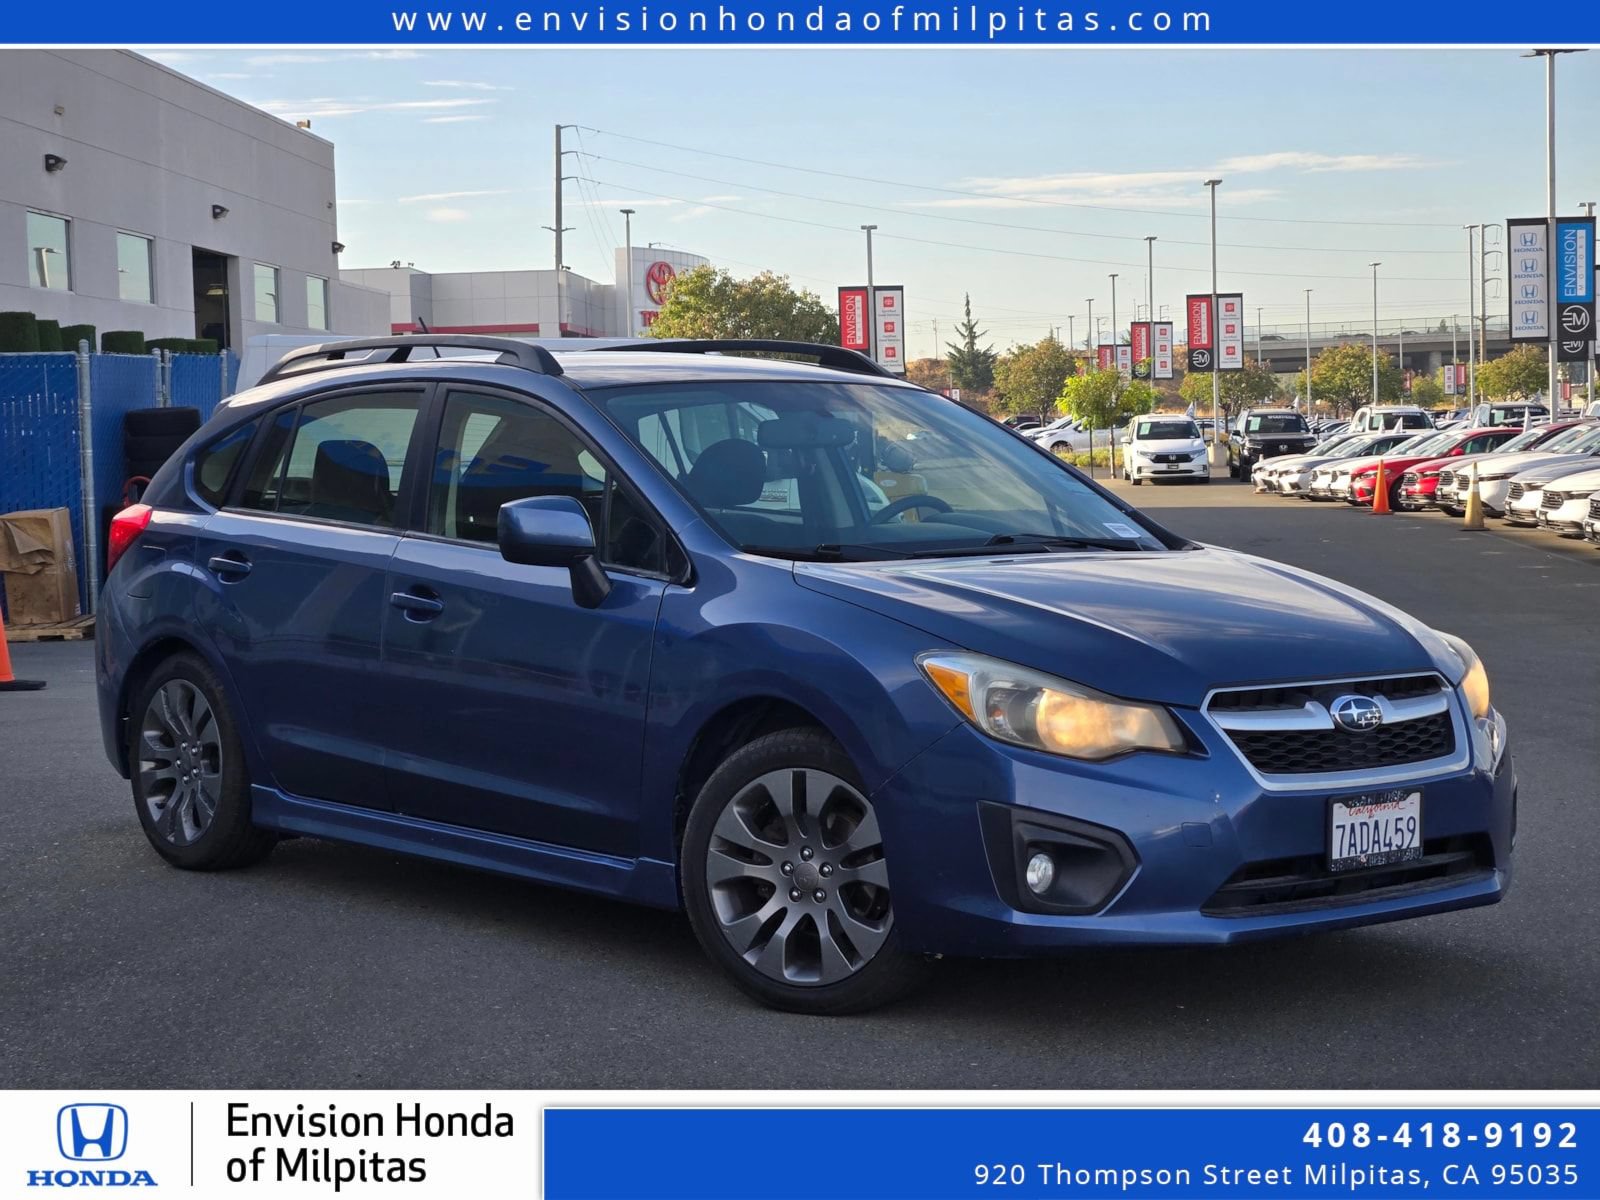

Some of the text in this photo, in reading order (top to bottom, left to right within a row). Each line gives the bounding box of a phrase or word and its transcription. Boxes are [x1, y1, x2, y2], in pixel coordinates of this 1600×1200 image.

[1564, 229, 1577, 297] ENVISION
[846, 295, 856, 345] ENVISION
[1193, 302, 1201, 345] ENVISION
[1335, 816, 1417, 858] 7ADA459
